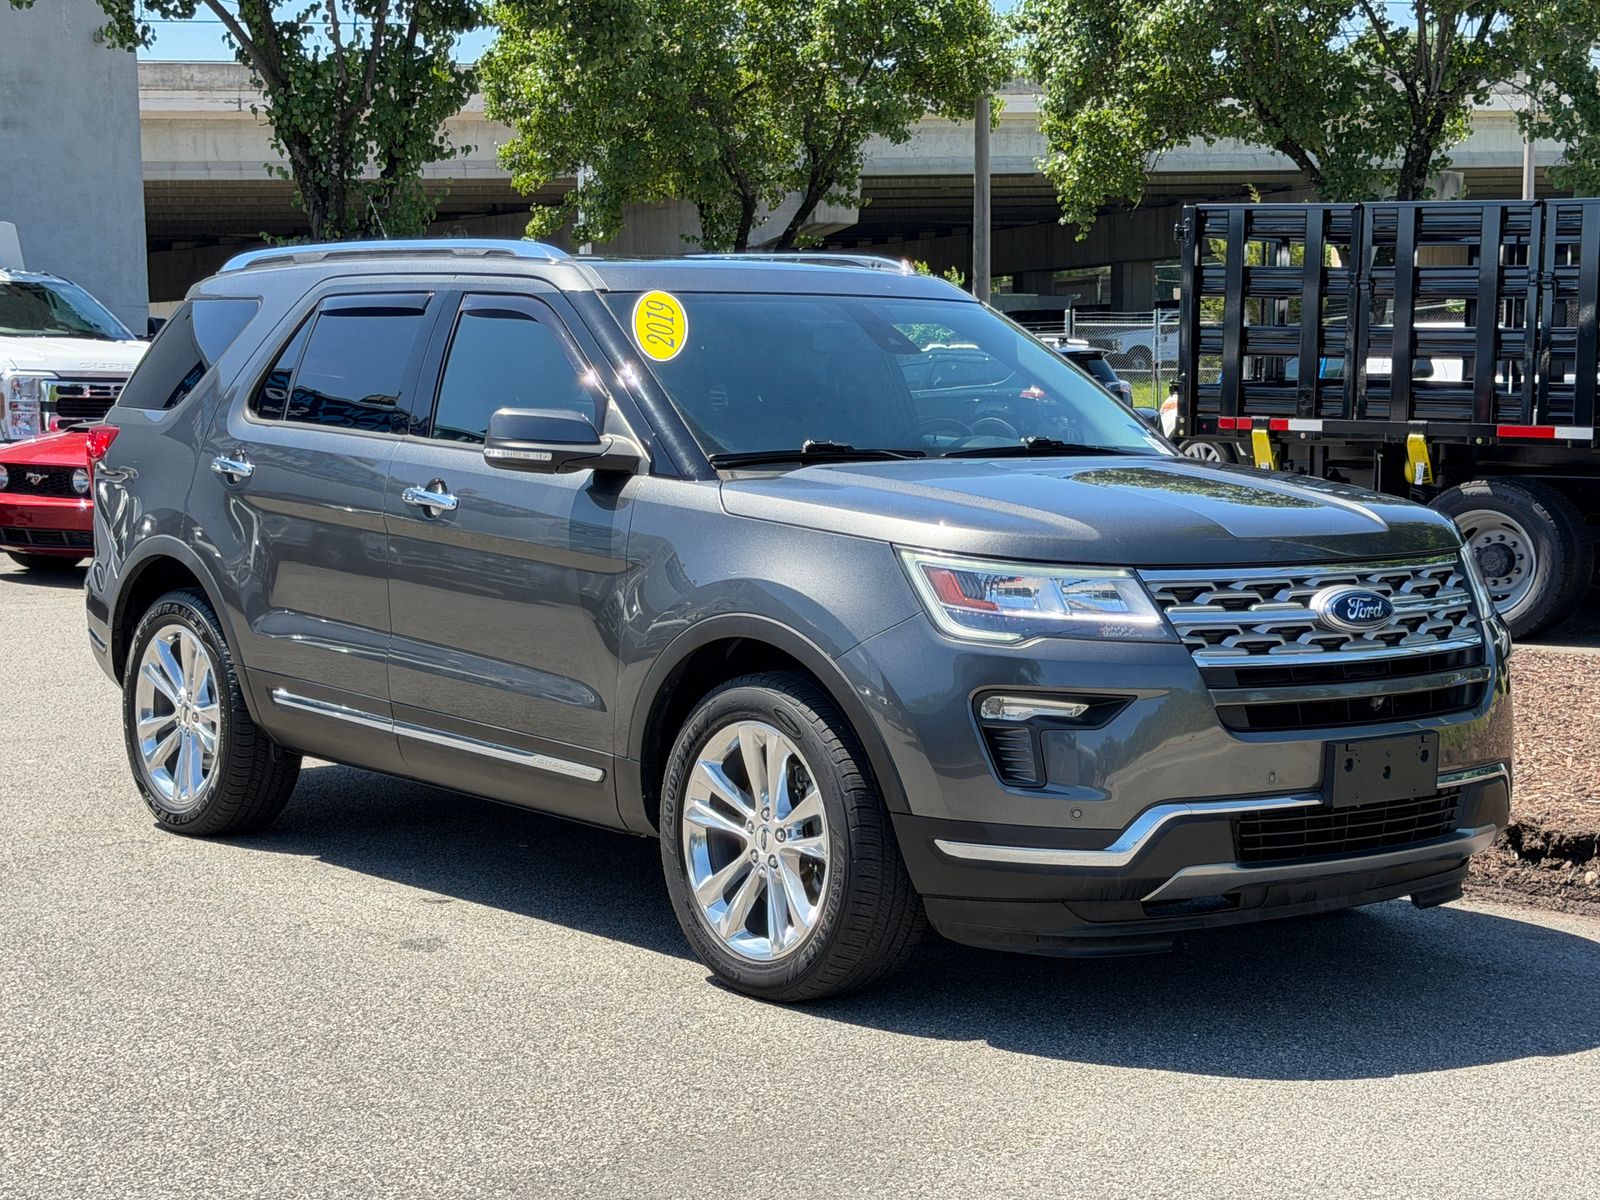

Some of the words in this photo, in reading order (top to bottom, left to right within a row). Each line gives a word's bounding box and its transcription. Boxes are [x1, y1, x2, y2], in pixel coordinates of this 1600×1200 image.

[646, 300, 675, 348] 2019
[80, 361, 136, 370] SUPE
[1347, 597, 1384, 619] Ford
[664, 721, 702, 827] GOODYEAR
[800, 857, 844, 966] ASSURANCE
